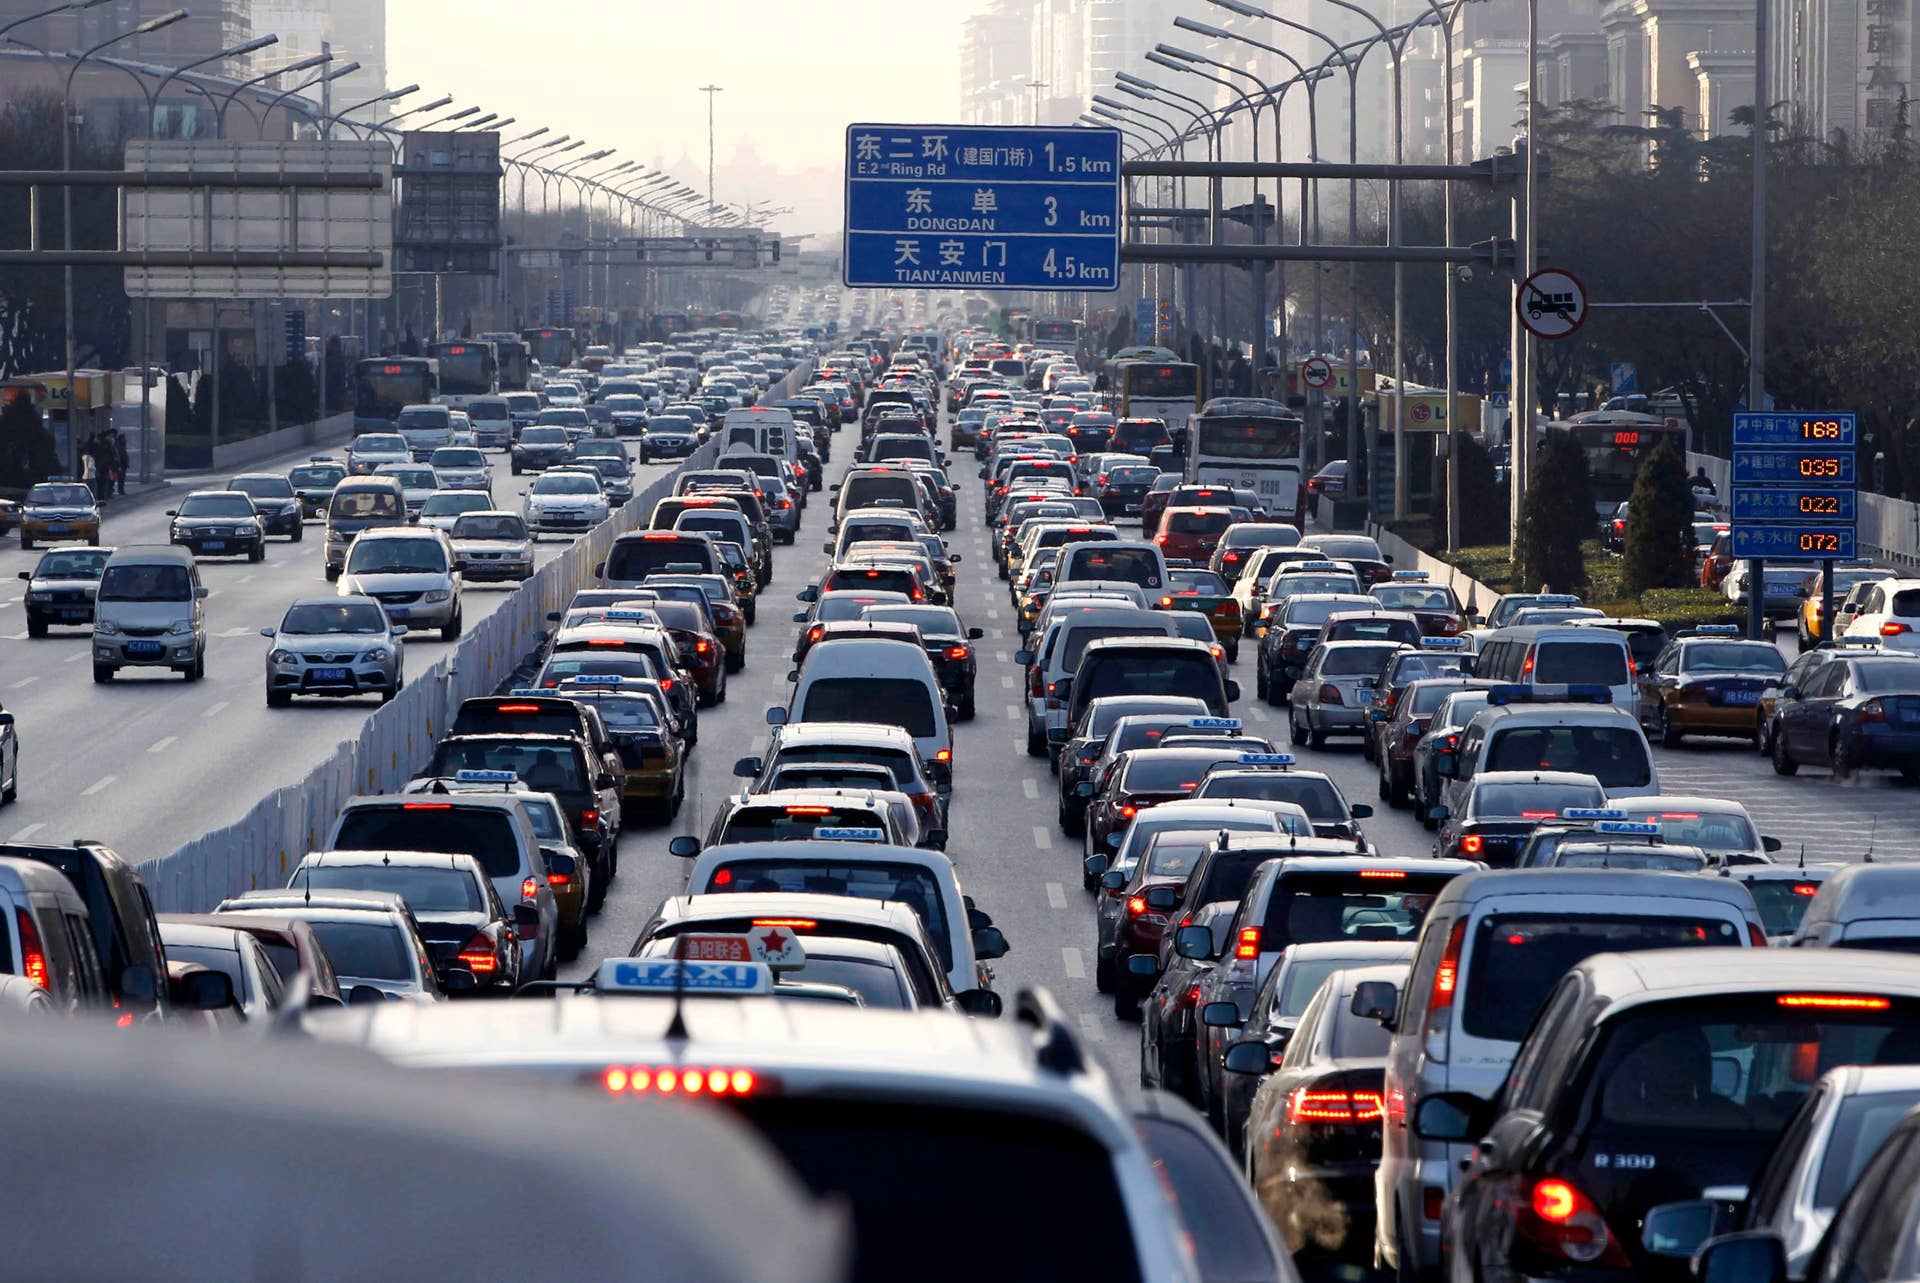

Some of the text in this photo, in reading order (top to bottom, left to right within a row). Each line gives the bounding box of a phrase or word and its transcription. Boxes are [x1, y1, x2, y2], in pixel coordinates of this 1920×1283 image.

[855, 133, 949, 162] 东二环
[1044, 142, 1076, 173] 1.5
[1081, 156, 1111, 173] km
[891, 162, 923, 177] Ring
[927, 162, 946, 176] Rd
[905, 187, 1111, 227] 东单 3 km
[907, 217, 995, 231] DONGDAN
[894, 239, 1110, 280] 天安门 4.5 km
[895, 269, 1005, 284] TIAN'ANMEN
[1803, 421, 1839, 438] 168
[1800, 459, 1839, 476] 035
[1800, 496, 1838, 513] 022
[1800, 534, 1838, 551] 072
[1197, 718, 1237, 727] TAXI
[1246, 754, 1288, 762] TAXI
[628, 964, 748, 981] TAXI
[1594, 1153, 1656, 1169] R 300
